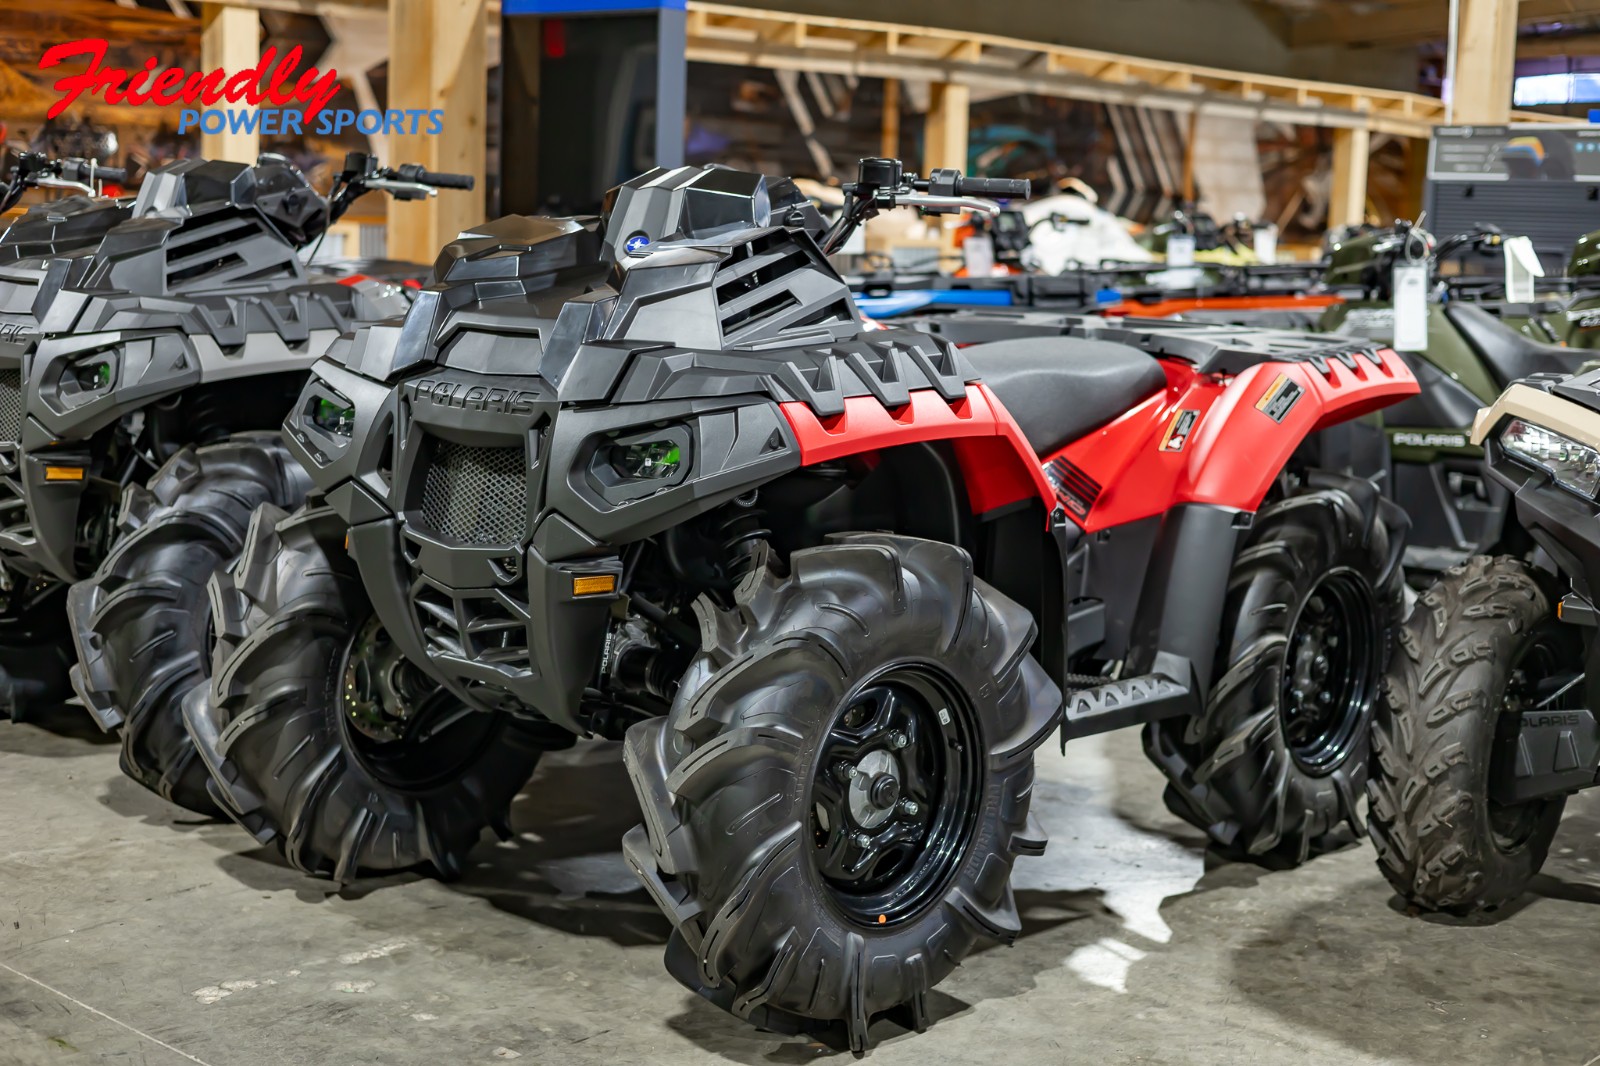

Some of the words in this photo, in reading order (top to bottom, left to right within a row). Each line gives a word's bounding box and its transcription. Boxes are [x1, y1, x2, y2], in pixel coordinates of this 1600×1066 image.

[413, 379, 541, 416] POLARIS
[1393, 432, 1465, 447] POLARIS
[601, 632, 612, 674] POLARIS
[1521, 714, 1579, 728] OLARIS
